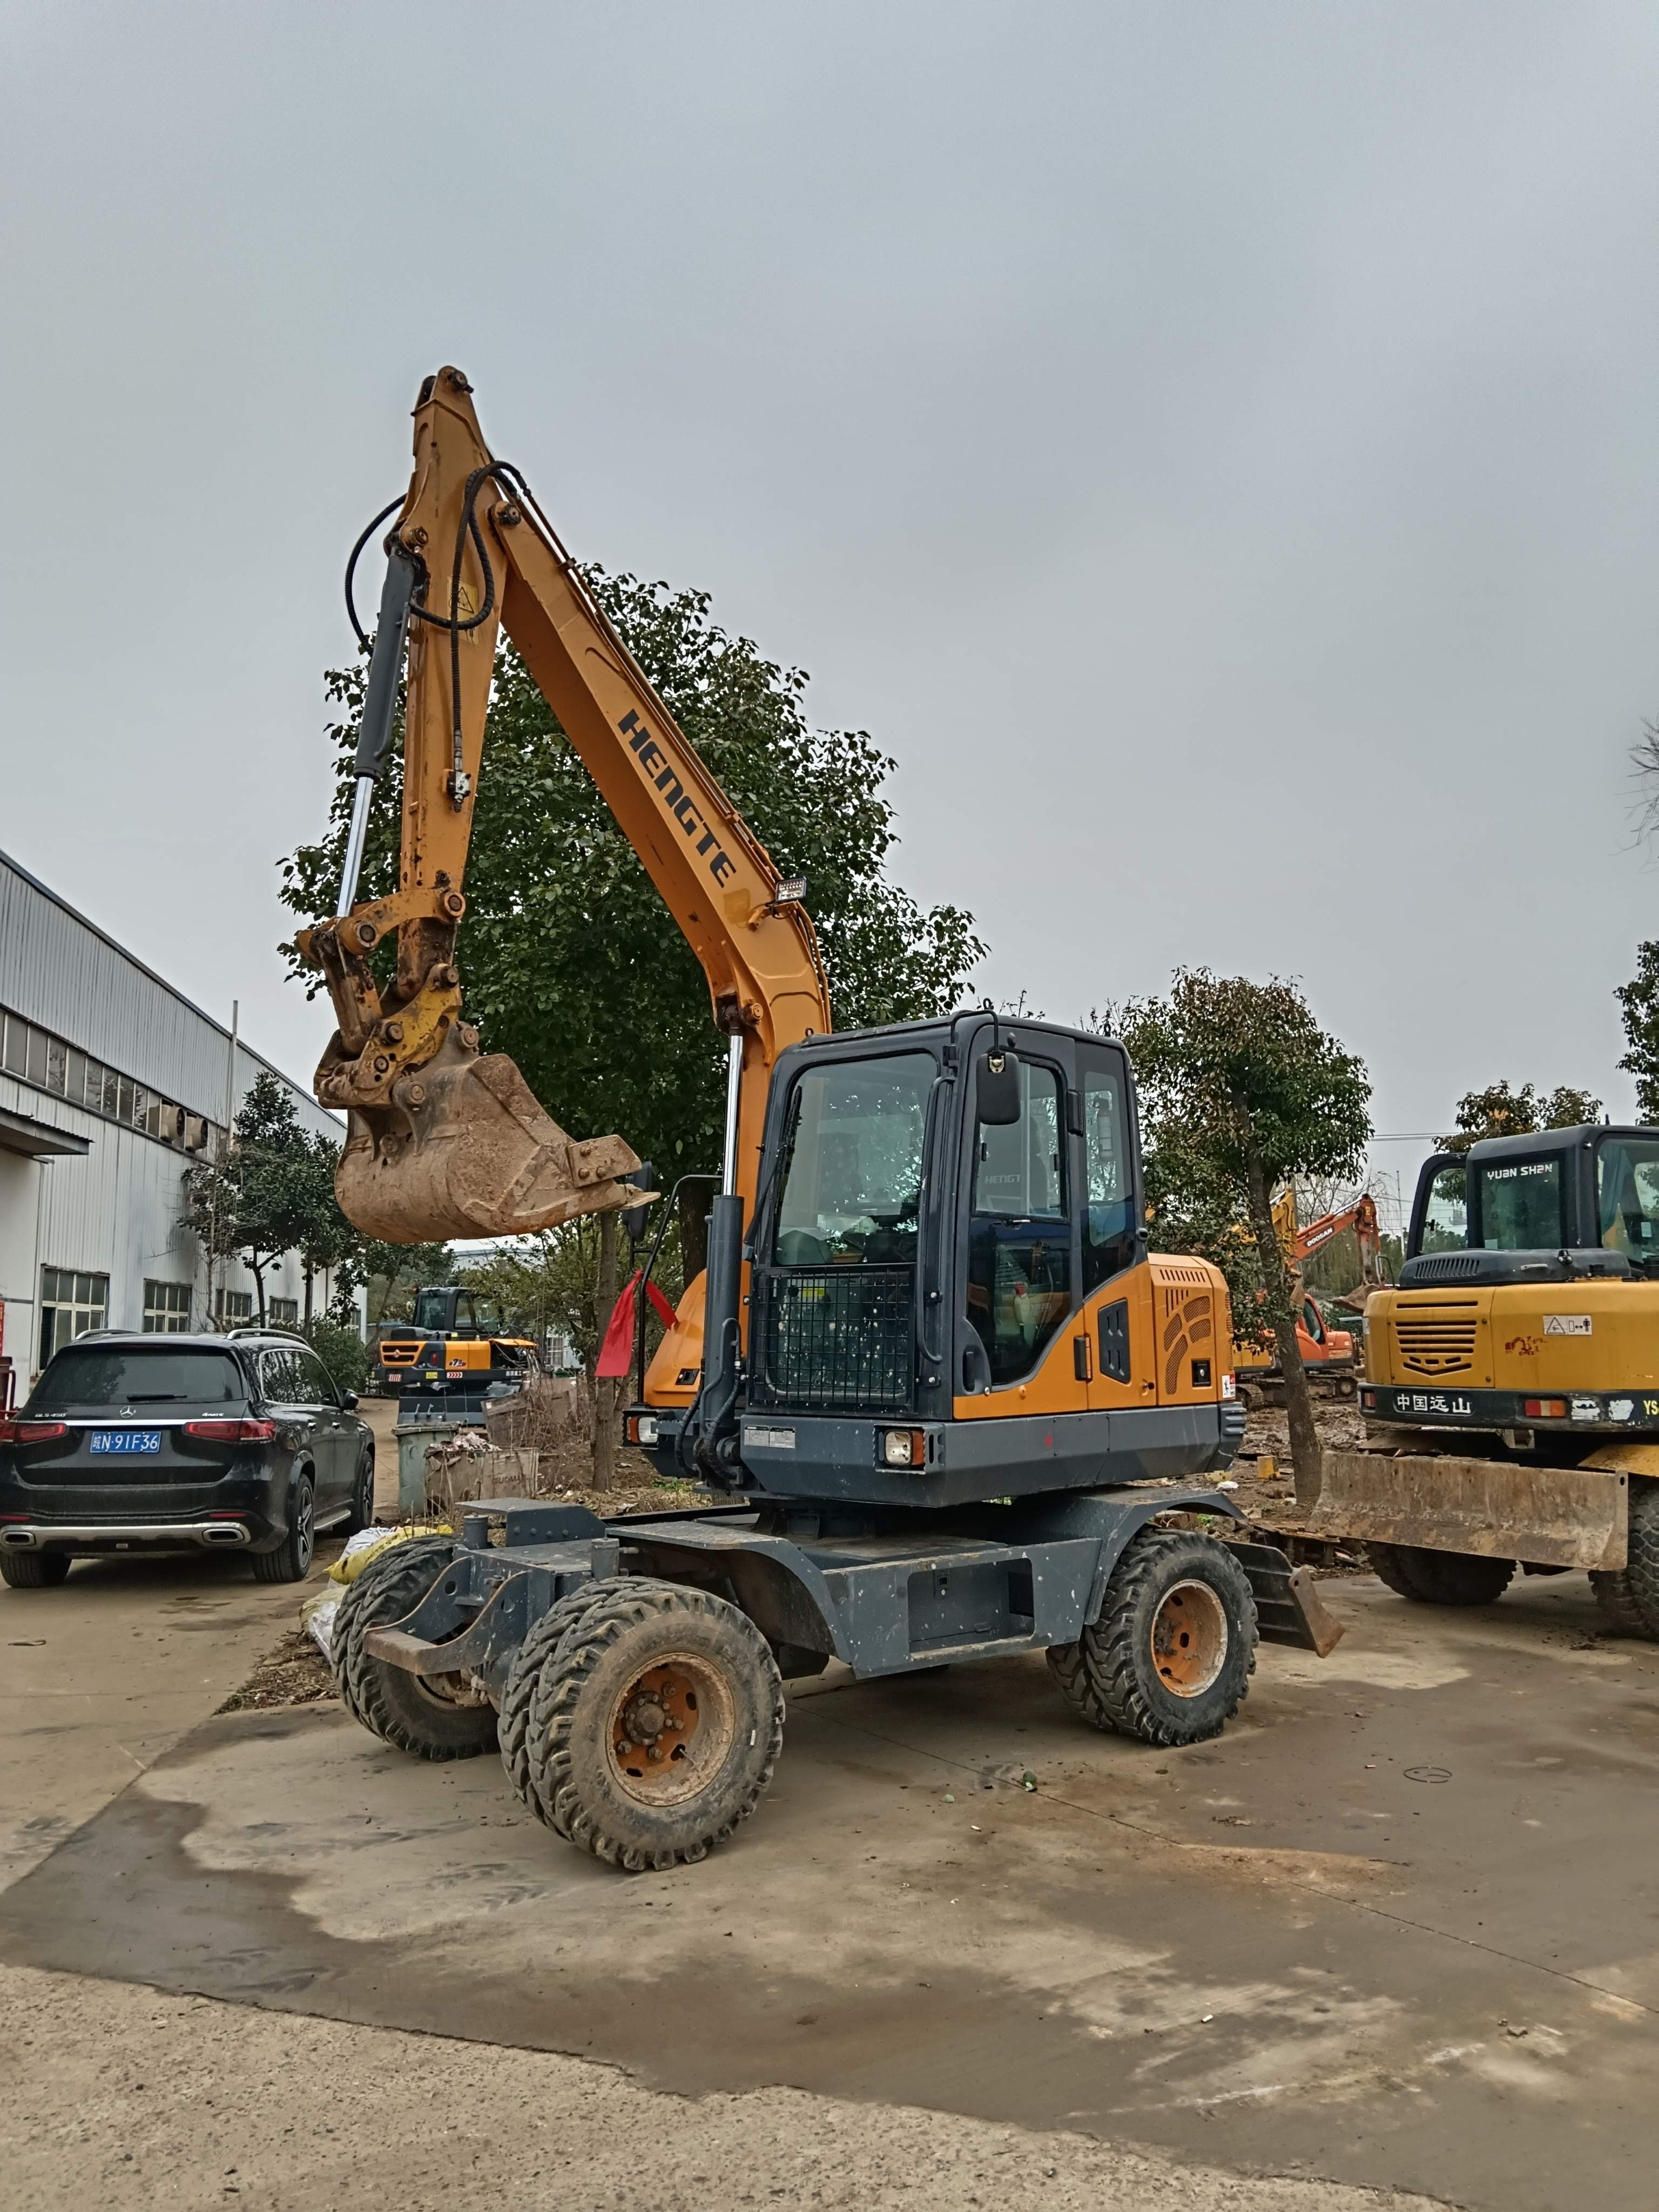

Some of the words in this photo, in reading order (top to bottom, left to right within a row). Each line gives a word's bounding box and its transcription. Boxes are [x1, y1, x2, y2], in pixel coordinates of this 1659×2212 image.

[617, 708, 737, 888] HENGTE
[1307, 1227, 1333, 1247] DOOSAN
[1397, 1393, 1471, 1414] 中国远山
[1643, 1400, 1659, 1415] YS
